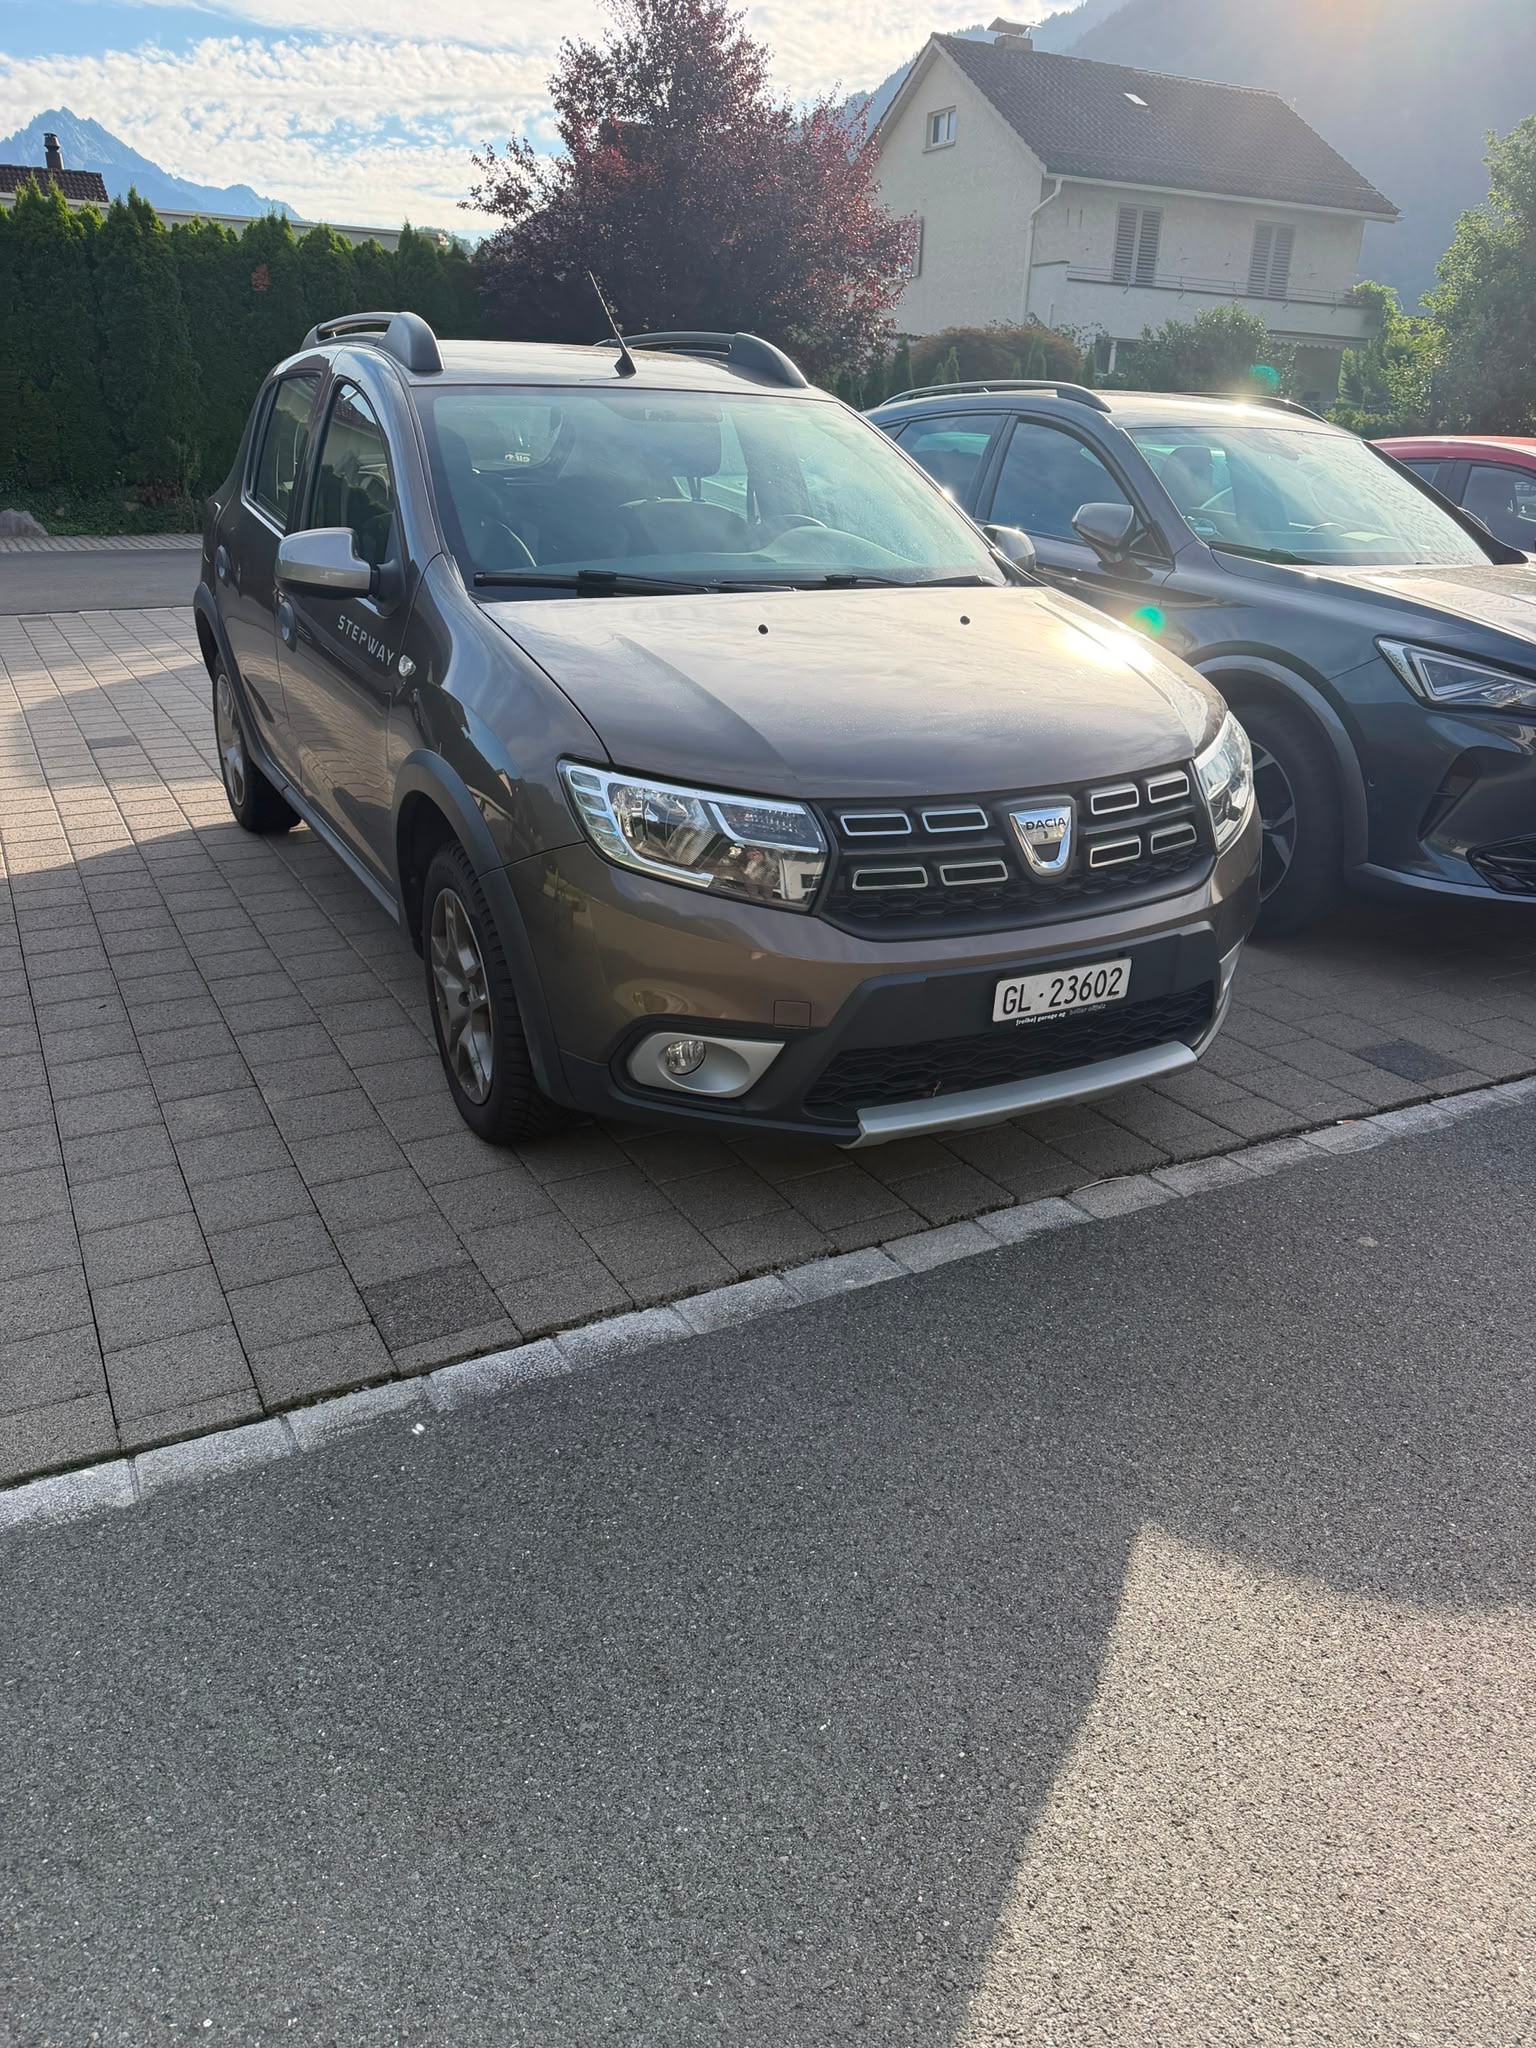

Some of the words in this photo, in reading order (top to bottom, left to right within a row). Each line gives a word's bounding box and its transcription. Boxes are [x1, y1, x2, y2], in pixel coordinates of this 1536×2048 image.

[337, 614, 395, 666] STEPWAY
[1025, 817, 1067, 830] DACIA
[1002, 984, 1031, 1015] GL
[1048, 967, 1123, 1008] 23602
